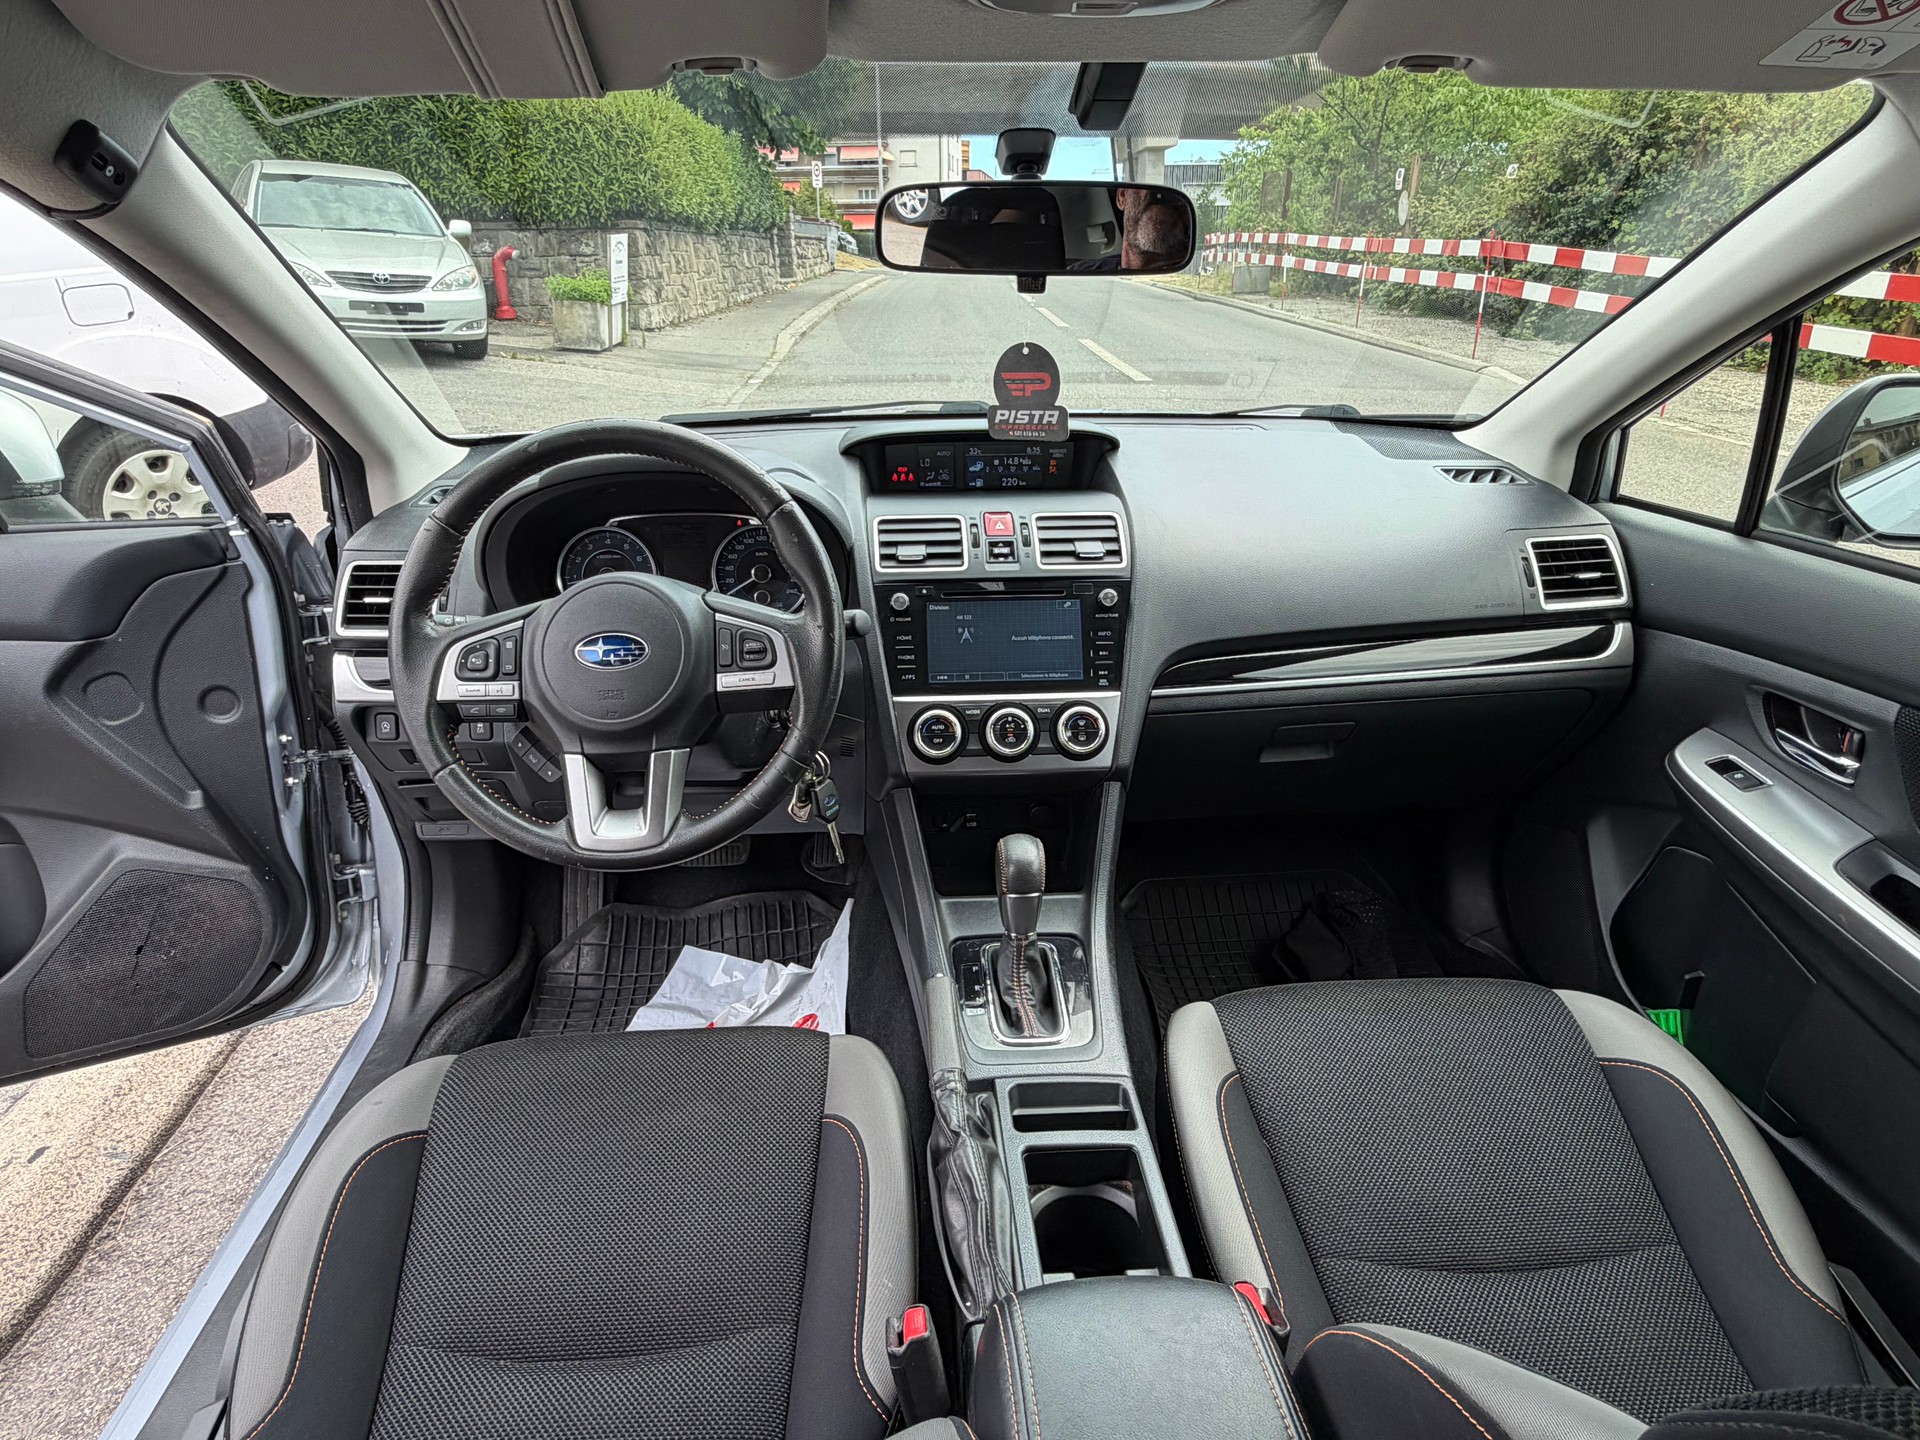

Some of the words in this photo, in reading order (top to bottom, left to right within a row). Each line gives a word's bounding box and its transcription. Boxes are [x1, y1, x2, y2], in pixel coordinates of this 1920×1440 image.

[994, 409, 1060, 424] PISTA
[1003, 457, 1019, 465] 14.8
[1001, 478, 1018, 486] 220
